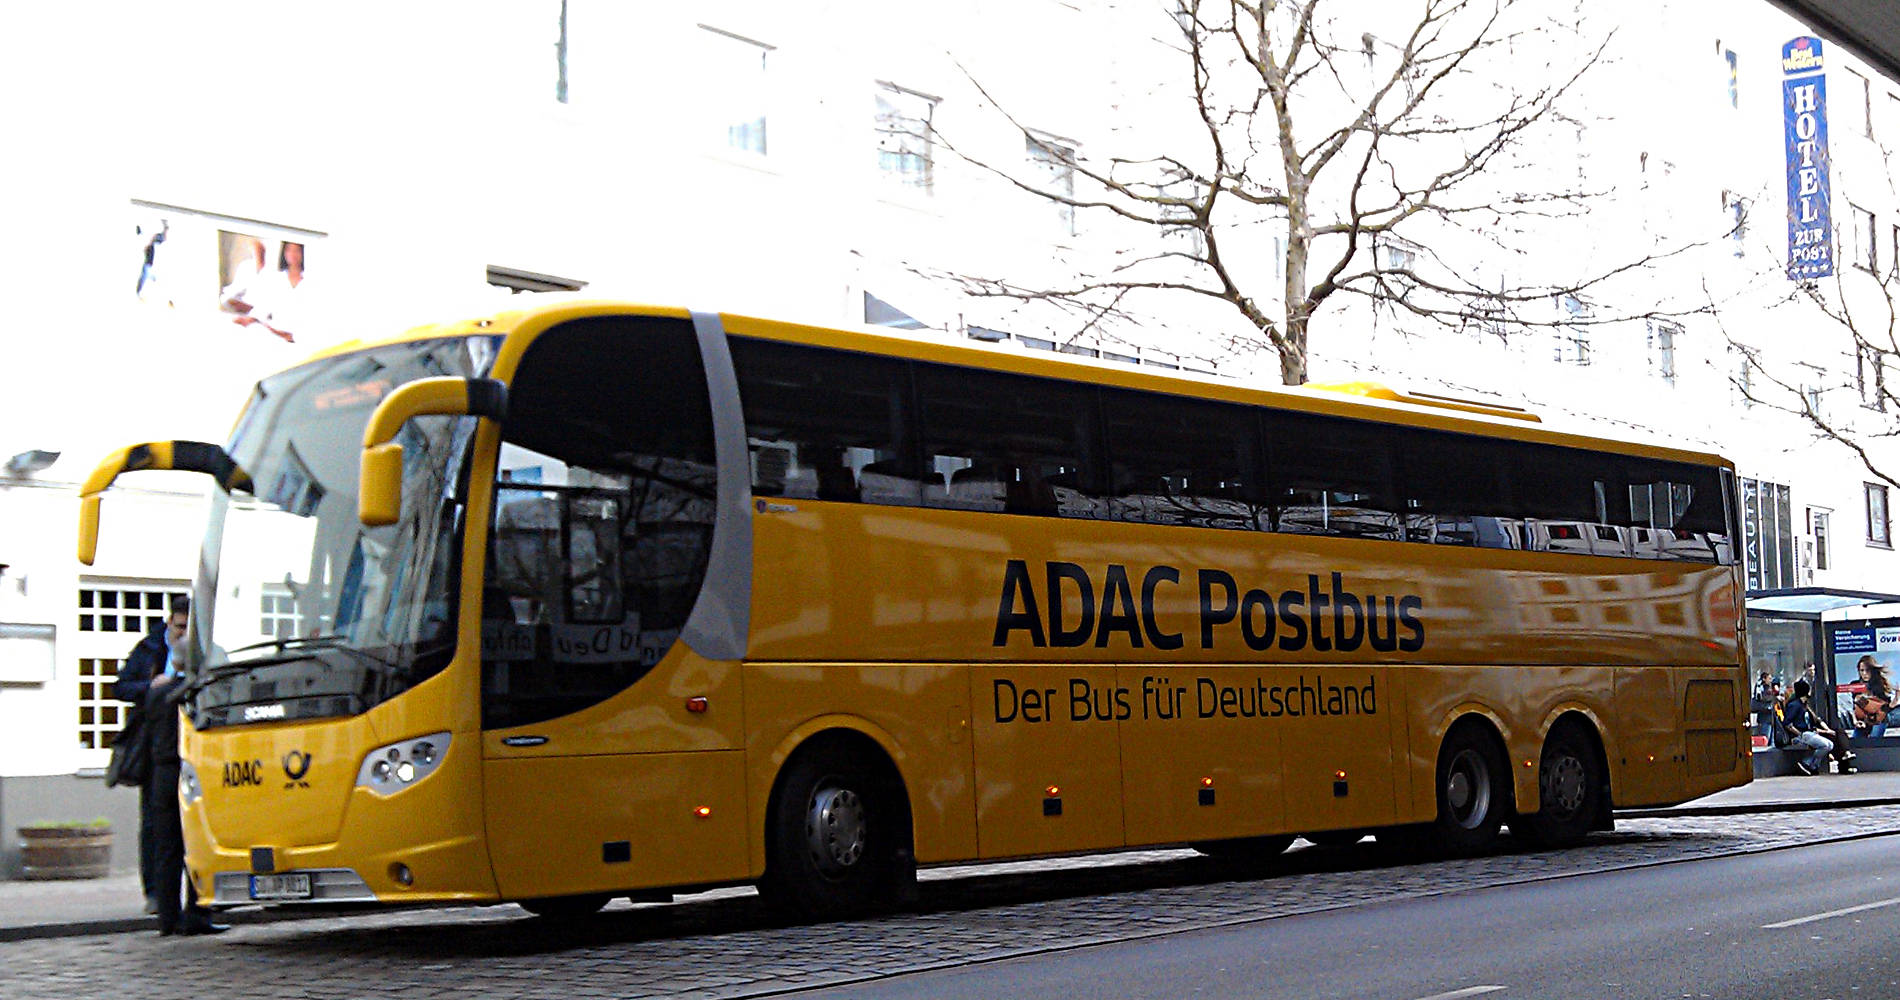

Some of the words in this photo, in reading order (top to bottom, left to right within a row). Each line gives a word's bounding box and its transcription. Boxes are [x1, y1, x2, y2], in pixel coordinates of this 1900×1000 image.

[1793, 84, 1817, 223] HOTEL
[1791, 247, 1829, 262] POST
[1795, 228, 1824, 245] ZUR
[1745, 484, 1758, 590] BEAUTY
[992, 559, 1185, 651] ADAC
[1198, 569, 1426, 653] Postbus
[993, 679, 1057, 724] Der
[1069, 678, 1131, 722] Bus
[1142, 676, 1187, 720] für
[1196, 675, 1377, 719] Deutschland
[222, 759, 263, 787] ADAC
